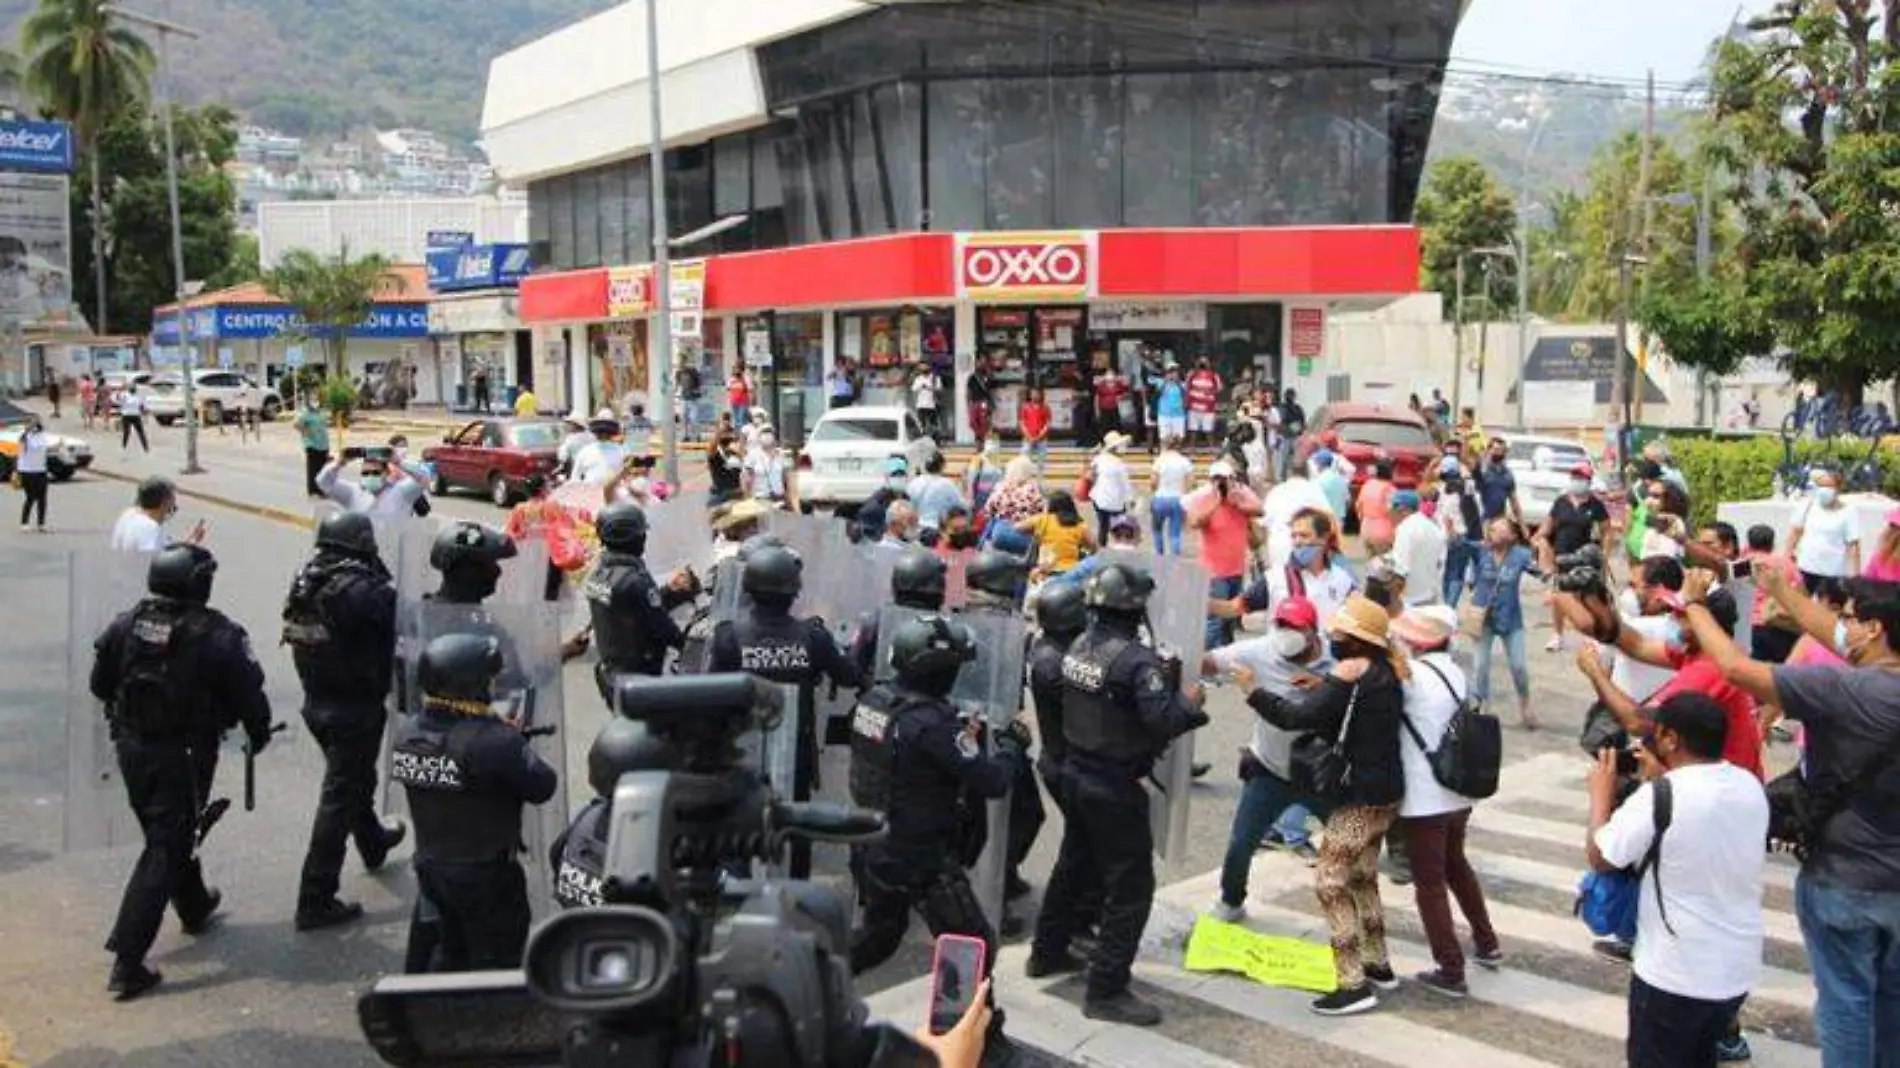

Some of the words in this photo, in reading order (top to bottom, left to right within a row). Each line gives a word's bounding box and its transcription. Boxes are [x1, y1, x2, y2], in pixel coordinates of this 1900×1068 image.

[967, 244, 1082, 287] OXXO
[223, 313, 284, 331] CENTRO
[742, 657, 809, 669] ESTATAL
[392, 766, 462, 785] ESTATAL
